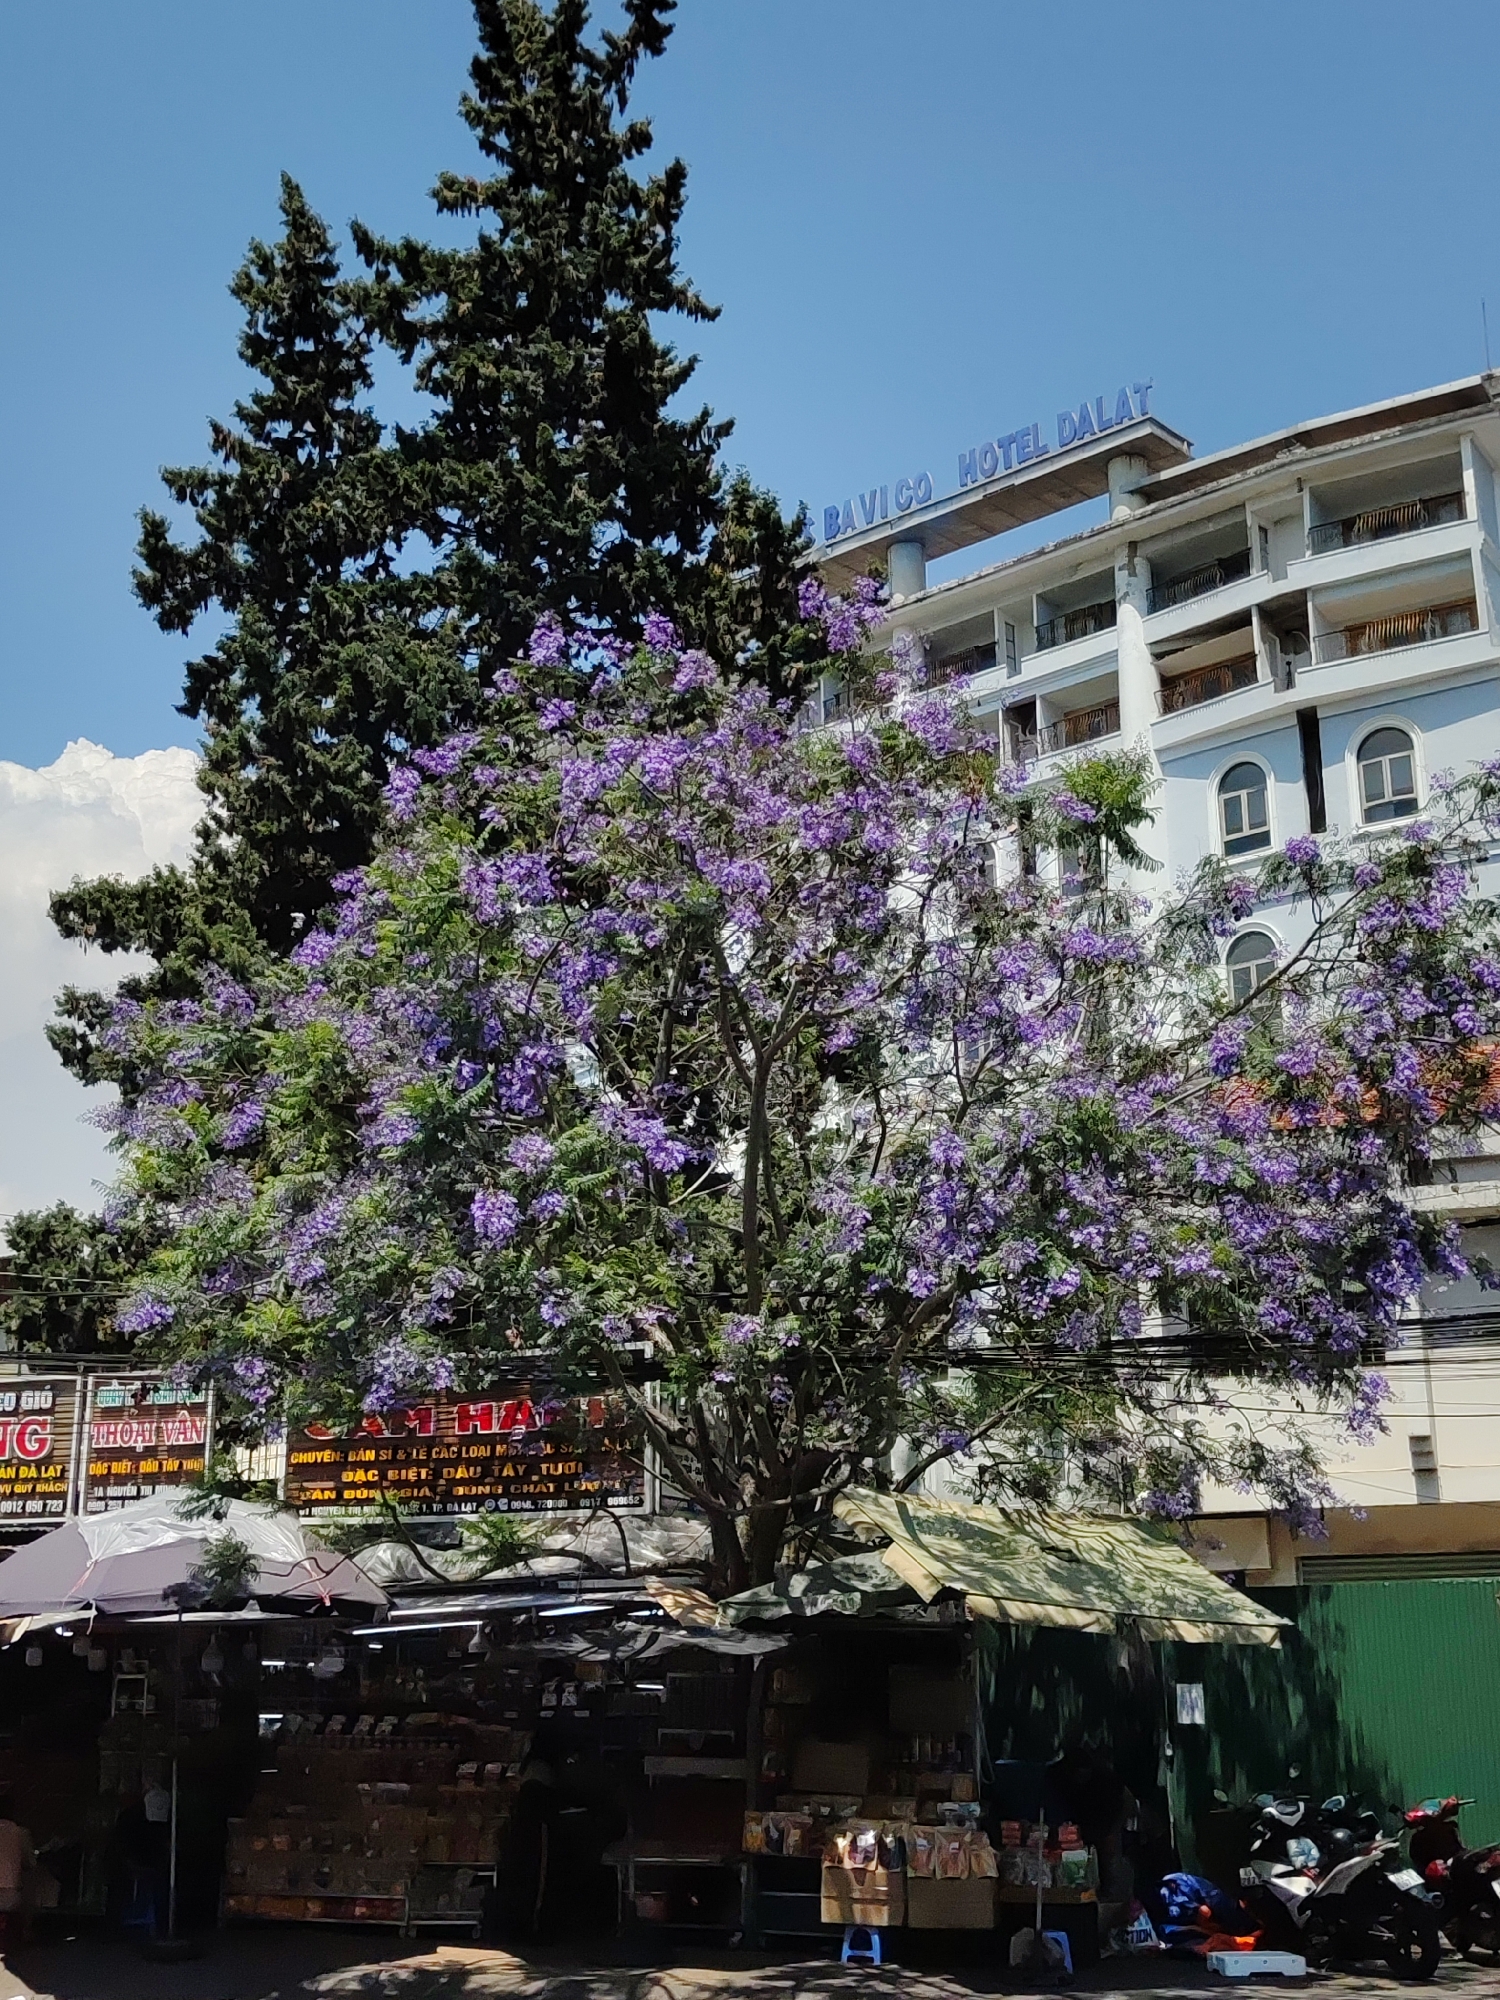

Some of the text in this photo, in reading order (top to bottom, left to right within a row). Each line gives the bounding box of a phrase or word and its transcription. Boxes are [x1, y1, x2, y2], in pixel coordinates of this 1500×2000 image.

[824, 470, 934, 541] BAVICO
[958, 422, 1050, 487] HOTEL
[1057, 380, 1153, 448] DALAT
[161, 1410, 206, 1445] VÂN
[41, 1464, 63, 1479] LẠT
[0, 1501, 23, 1513] 0912
[45, 1499, 64, 1511] 723
